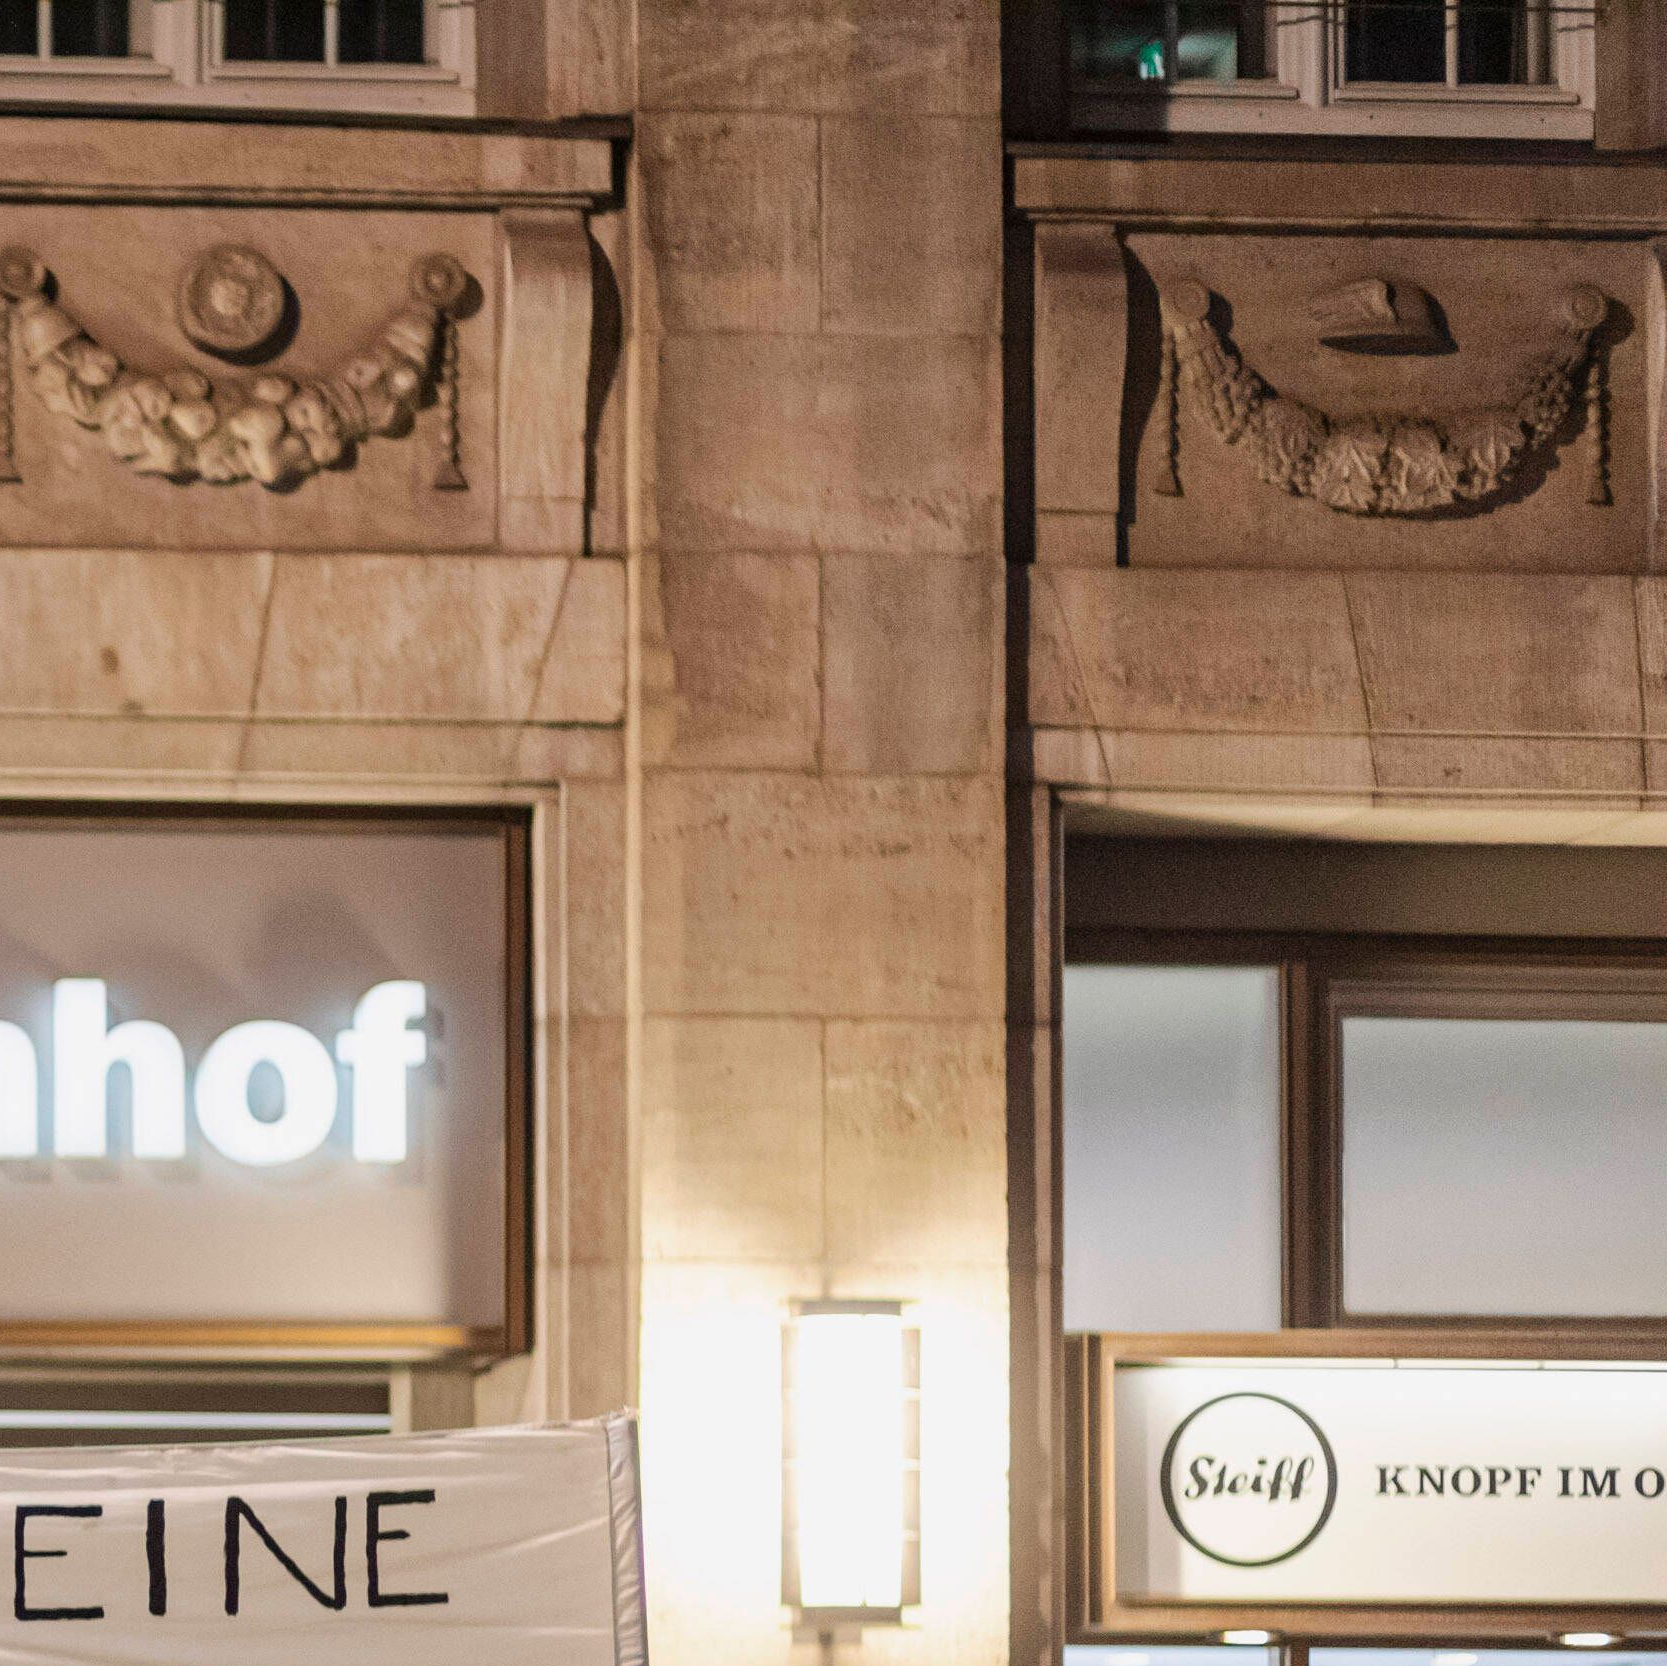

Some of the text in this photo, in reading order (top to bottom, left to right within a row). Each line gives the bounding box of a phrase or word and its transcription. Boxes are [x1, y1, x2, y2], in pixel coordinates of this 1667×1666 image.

[1184, 1455, 1315, 1503] Steiff
[1376, 1464, 1543, 1498] KNOPF
[1557, 1466, 1622, 1499] IM
